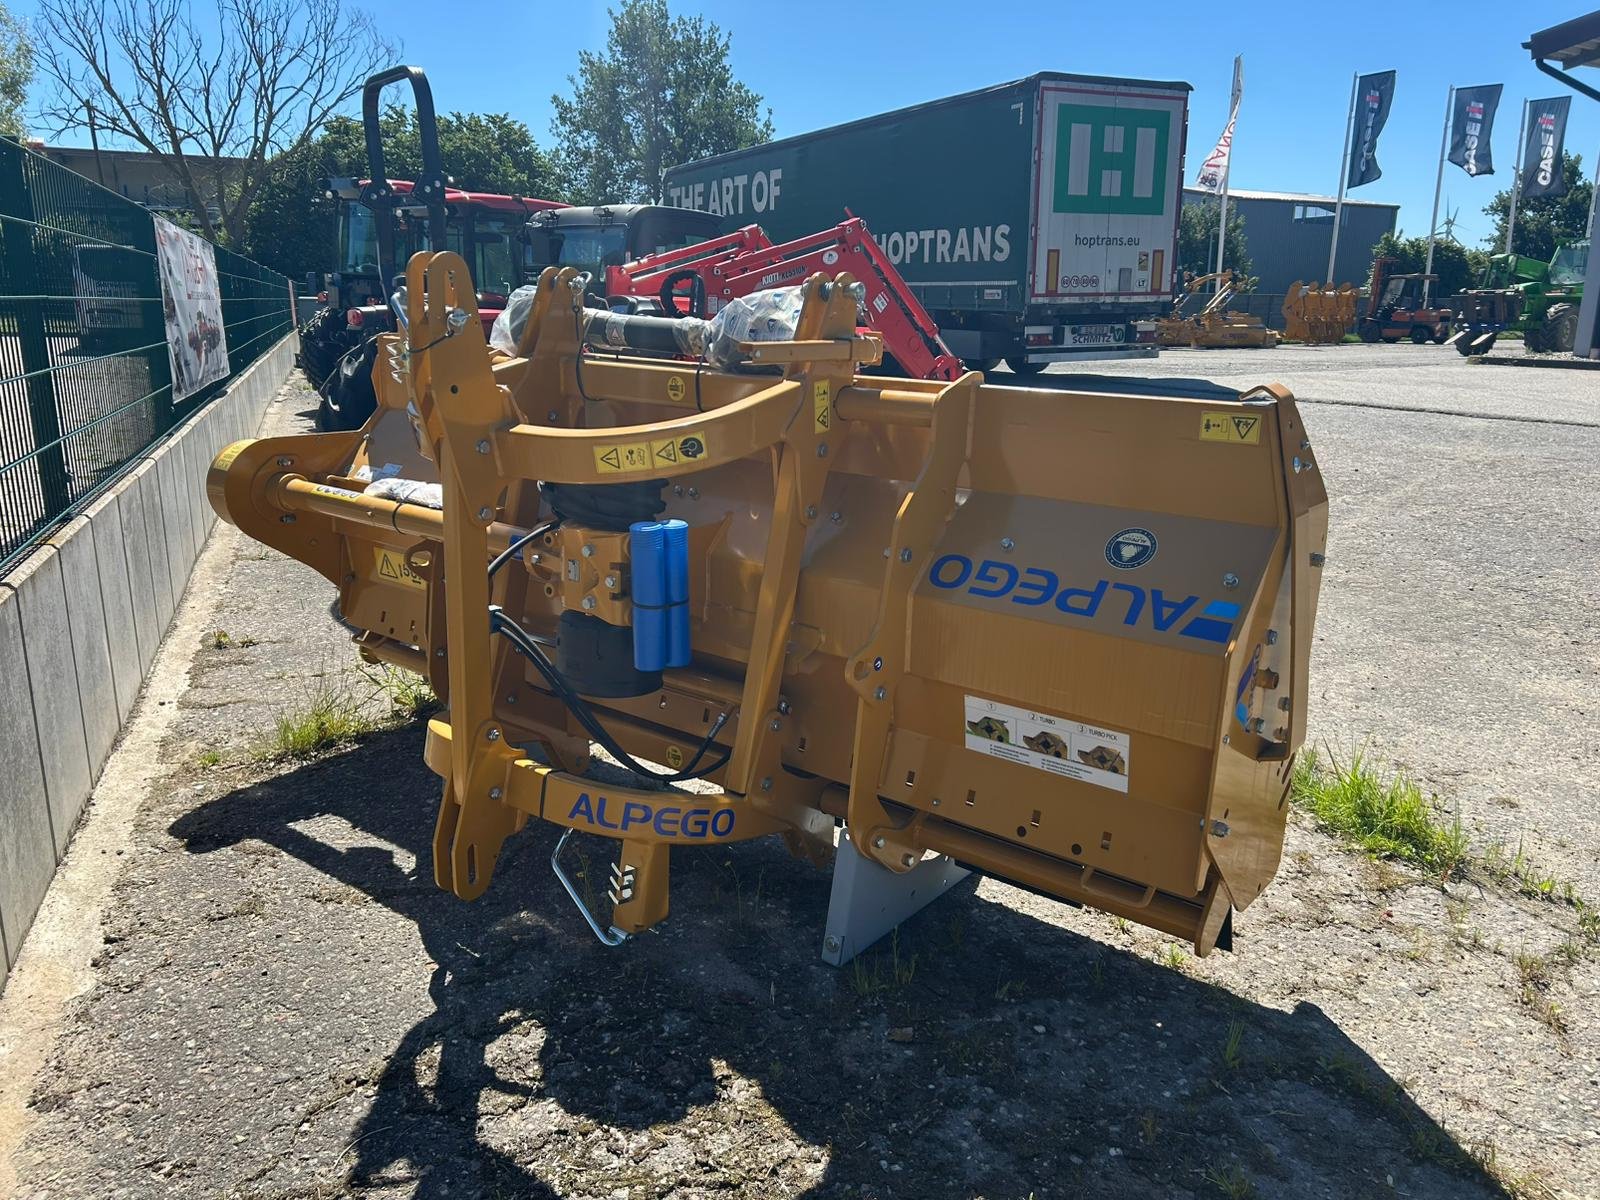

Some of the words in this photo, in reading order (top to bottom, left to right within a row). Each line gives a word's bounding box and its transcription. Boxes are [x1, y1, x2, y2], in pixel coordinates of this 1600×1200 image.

[1537, 132, 1554, 186] CASE
[670, 183, 705, 209] THE
[708, 174, 748, 215] ART
[751, 168, 782, 213] OF
[872, 224, 1011, 265] HOPTRANS
[1074, 234, 1140, 248] hoptrans.eu
[761, 272, 780, 286] KIOTI
[1072, 334, 1112, 344] SCHMITZ
[928, 554, 1201, 632] ALPEGO
[1039, 715, 1056, 726] TURBO
[1088, 728, 1105, 739] TURBO
[1105, 731, 1119, 741] PICK
[568, 793, 736, 838] ALPEGO
